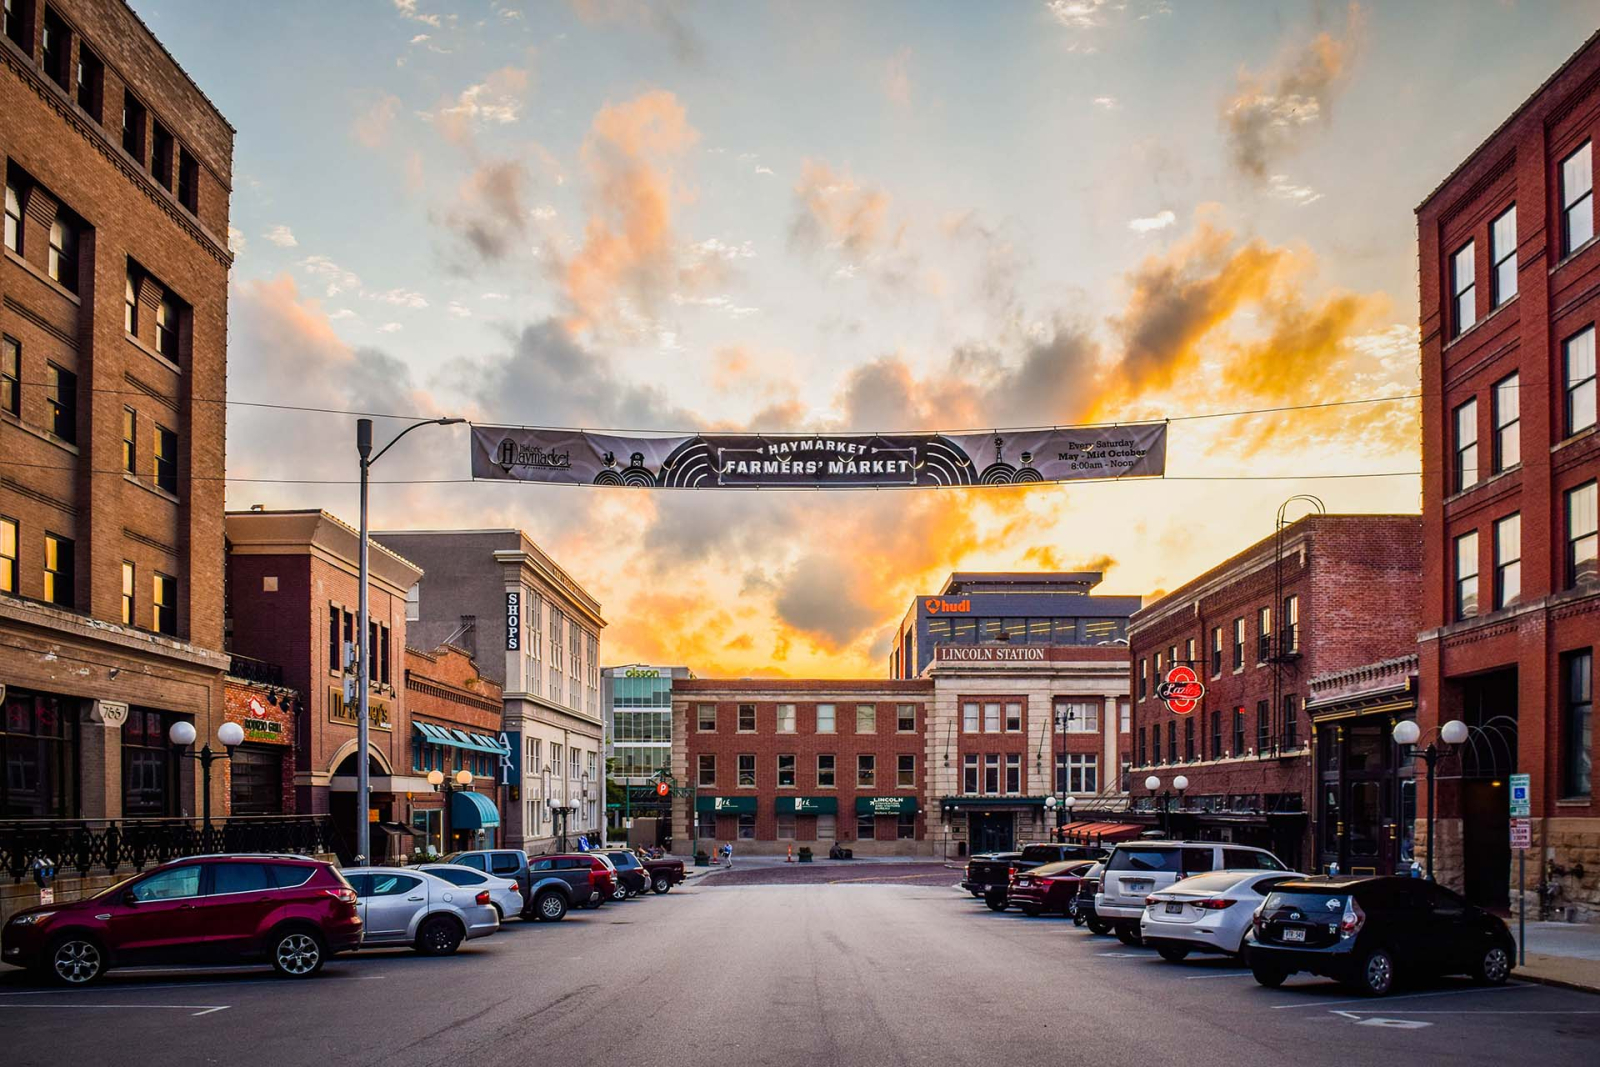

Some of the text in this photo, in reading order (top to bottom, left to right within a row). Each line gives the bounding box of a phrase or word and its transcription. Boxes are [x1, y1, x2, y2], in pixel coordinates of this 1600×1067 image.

[768, 440, 867, 455] HAYMARKET
[1069, 439, 1135, 451] Every Saturday
[1058, 452, 1079, 461] May
[1087, 449, 1106, 459] Mid
[1108, 449, 1147, 458] October
[828, 461, 909, 474] MARKET
[1070, 462, 1103, 470] 8:00am
[1110, 460, 1134, 468] Noon
[941, 600, 971, 612] hudl
[508, 593, 518, 649] SHOPS
[942, 648, 1045, 660] LINCOLN STATION
[625, 667, 659, 678] olsson
[103, 706, 121, 720] 755
[500, 732, 514, 785] ART
